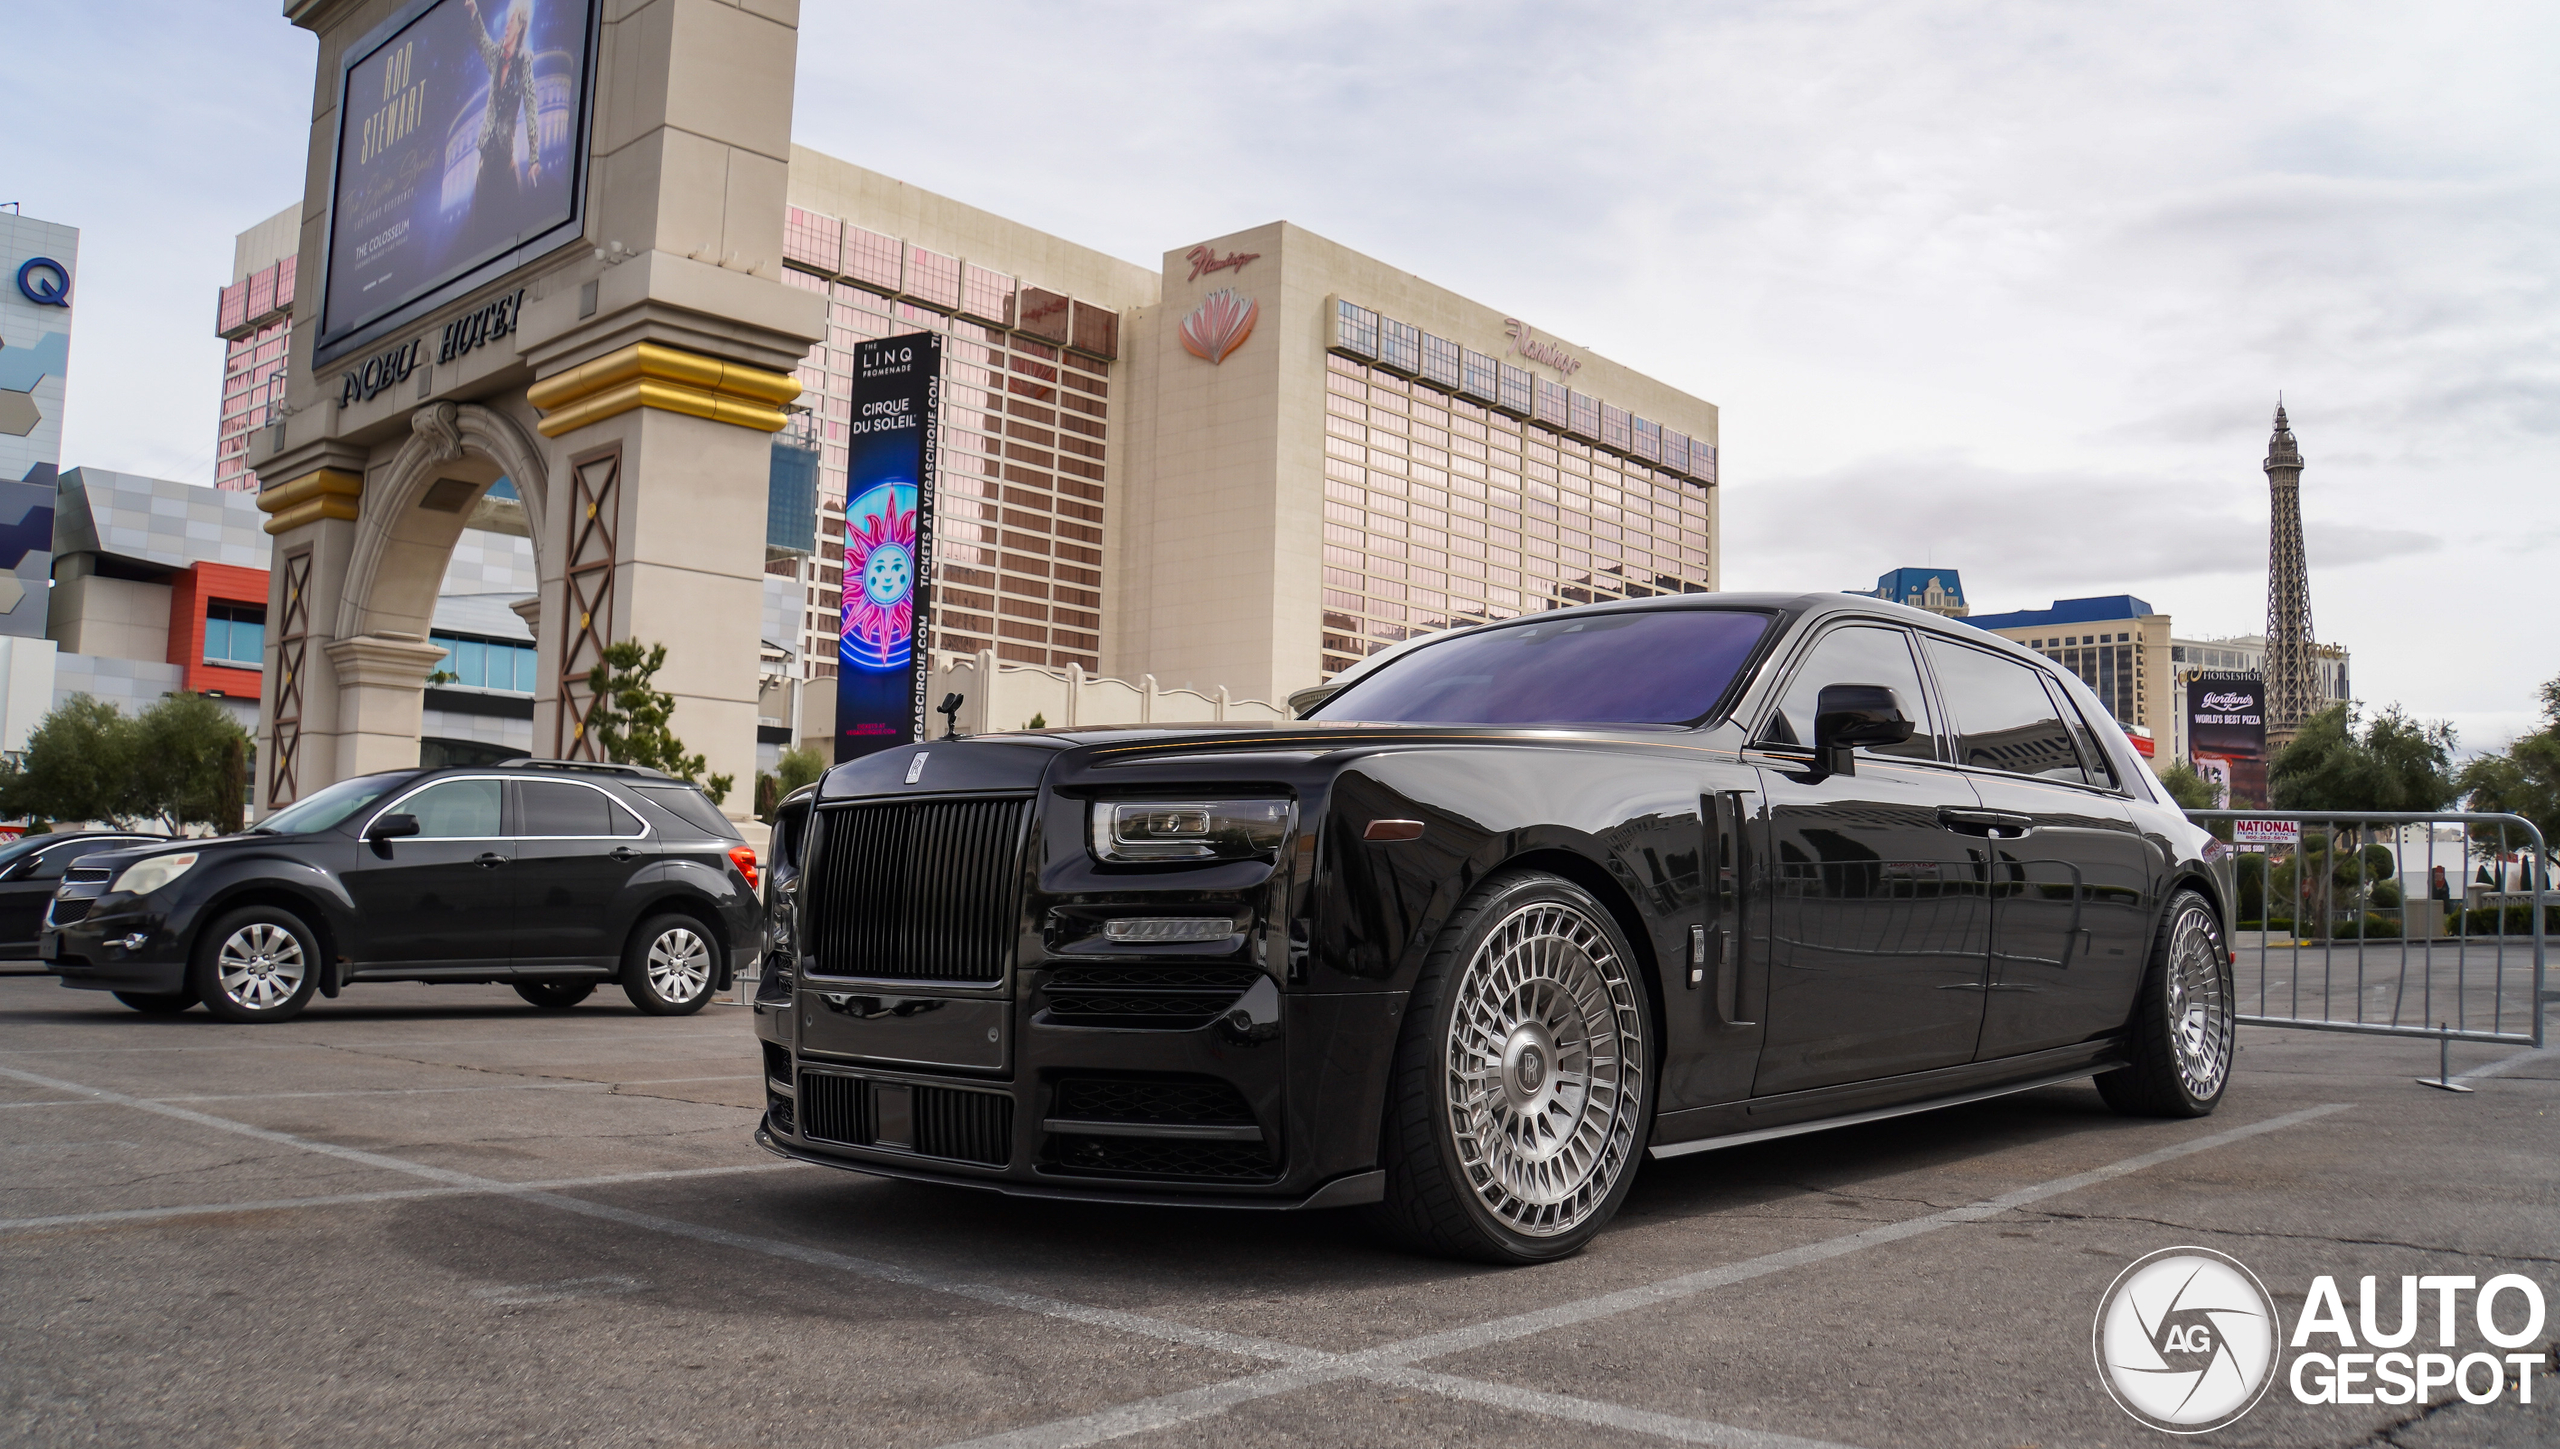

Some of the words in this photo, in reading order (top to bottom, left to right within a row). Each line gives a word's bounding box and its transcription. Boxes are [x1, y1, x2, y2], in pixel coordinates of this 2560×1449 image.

[383, 41, 412, 102] ROD
[361, 79, 426, 165] STEWART
[356, 242, 368, 261] THE
[369, 218, 410, 253] COLOSSEUM
[1186, 245, 1261, 282] Flamingo
[18, 257, 71, 308] Q
[863, 347, 913, 368] LINQ
[864, 342, 877, 351] THE
[1504, 317, 1582, 382] Flamingo
[338, 338, 421, 409] NOBU
[862, 364, 912, 378] PROMENADE
[862, 398, 910, 416] CIRQUE
[853, 420, 871, 435] DU
[873, 414, 917, 432] SOLEIL
[924, 375, 938, 507] VEGASCIRQUE.COM
[923, 511, 931, 529] AT
[920, 531, 931, 587] TICKETS
[914, 615, 928, 743] EGASCIRQUE.COM
[2203, 671, 2262, 681] HORSESHOE
[2201, 691, 2253, 710] Giordano's
[2194, 714, 2223, 724] WORLD'S
[2224, 714, 2241, 725] BEST
[2242, 715, 2261, 725] PIZZA
[2237, 821, 2297, 832] NATIONAL
